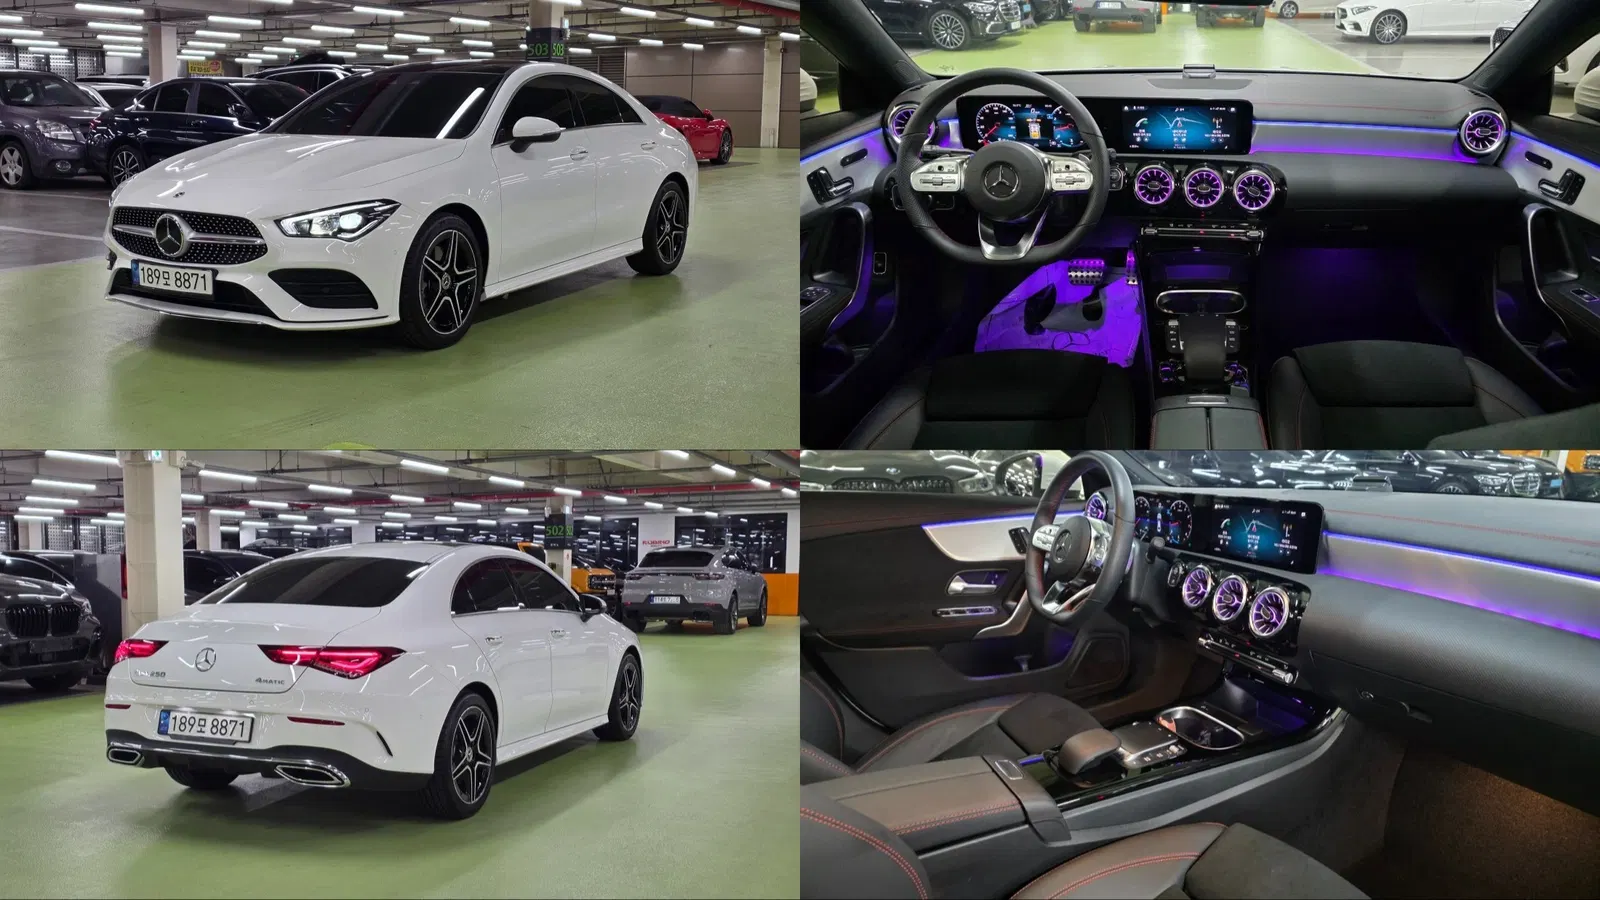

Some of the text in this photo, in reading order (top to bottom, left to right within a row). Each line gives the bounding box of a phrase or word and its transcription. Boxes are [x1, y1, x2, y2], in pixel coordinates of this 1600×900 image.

[528, 43, 549, 56] 503
[552, 43, 565, 56] 503
[141, 266, 207, 291] 189모 8871
[546, 525, 565, 536] 502
[171, 715, 245, 738] 189모 8871
